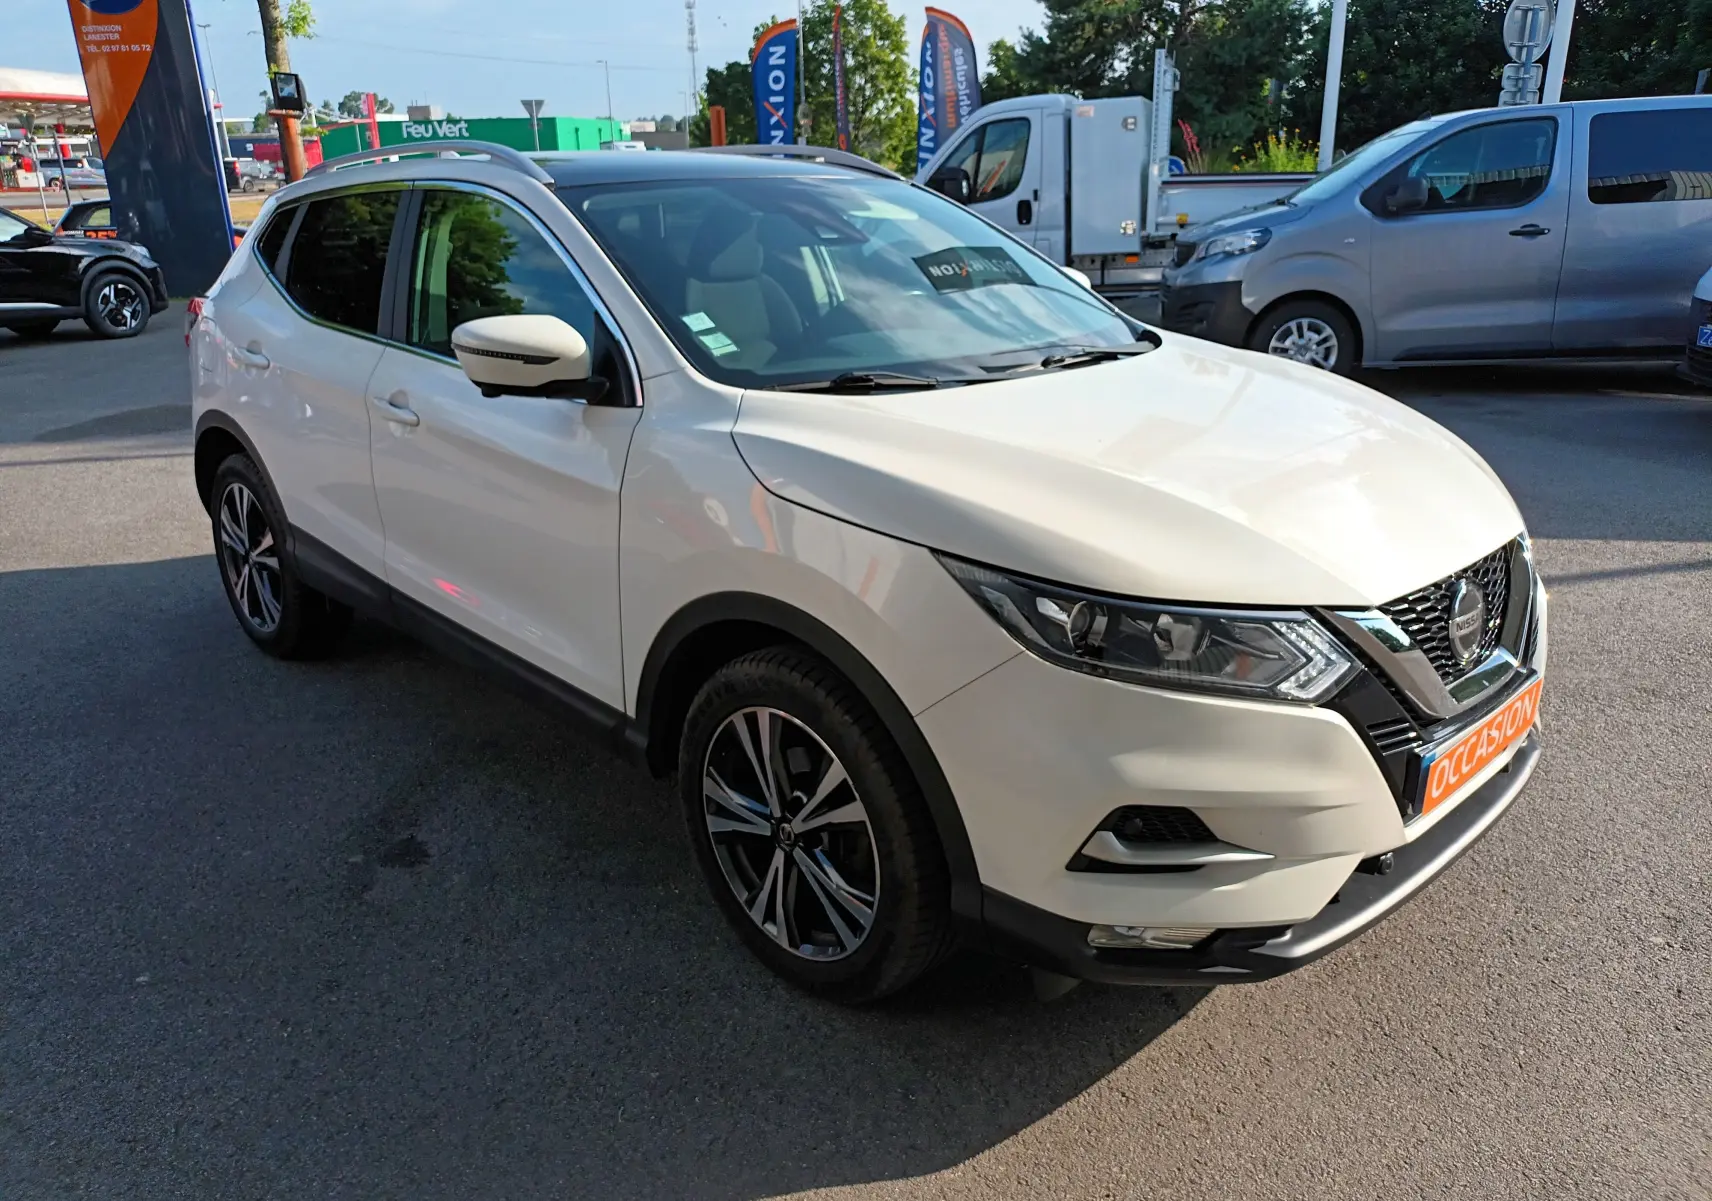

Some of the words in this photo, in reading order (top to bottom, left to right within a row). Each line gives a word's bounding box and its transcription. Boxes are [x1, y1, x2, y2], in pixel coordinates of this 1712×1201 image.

[83, 33, 120, 41] LANESTER
[402, 121, 433, 139] Feu
[434, 120, 470, 138] Vert
[1431, 686, 1537, 799] OCCASION
